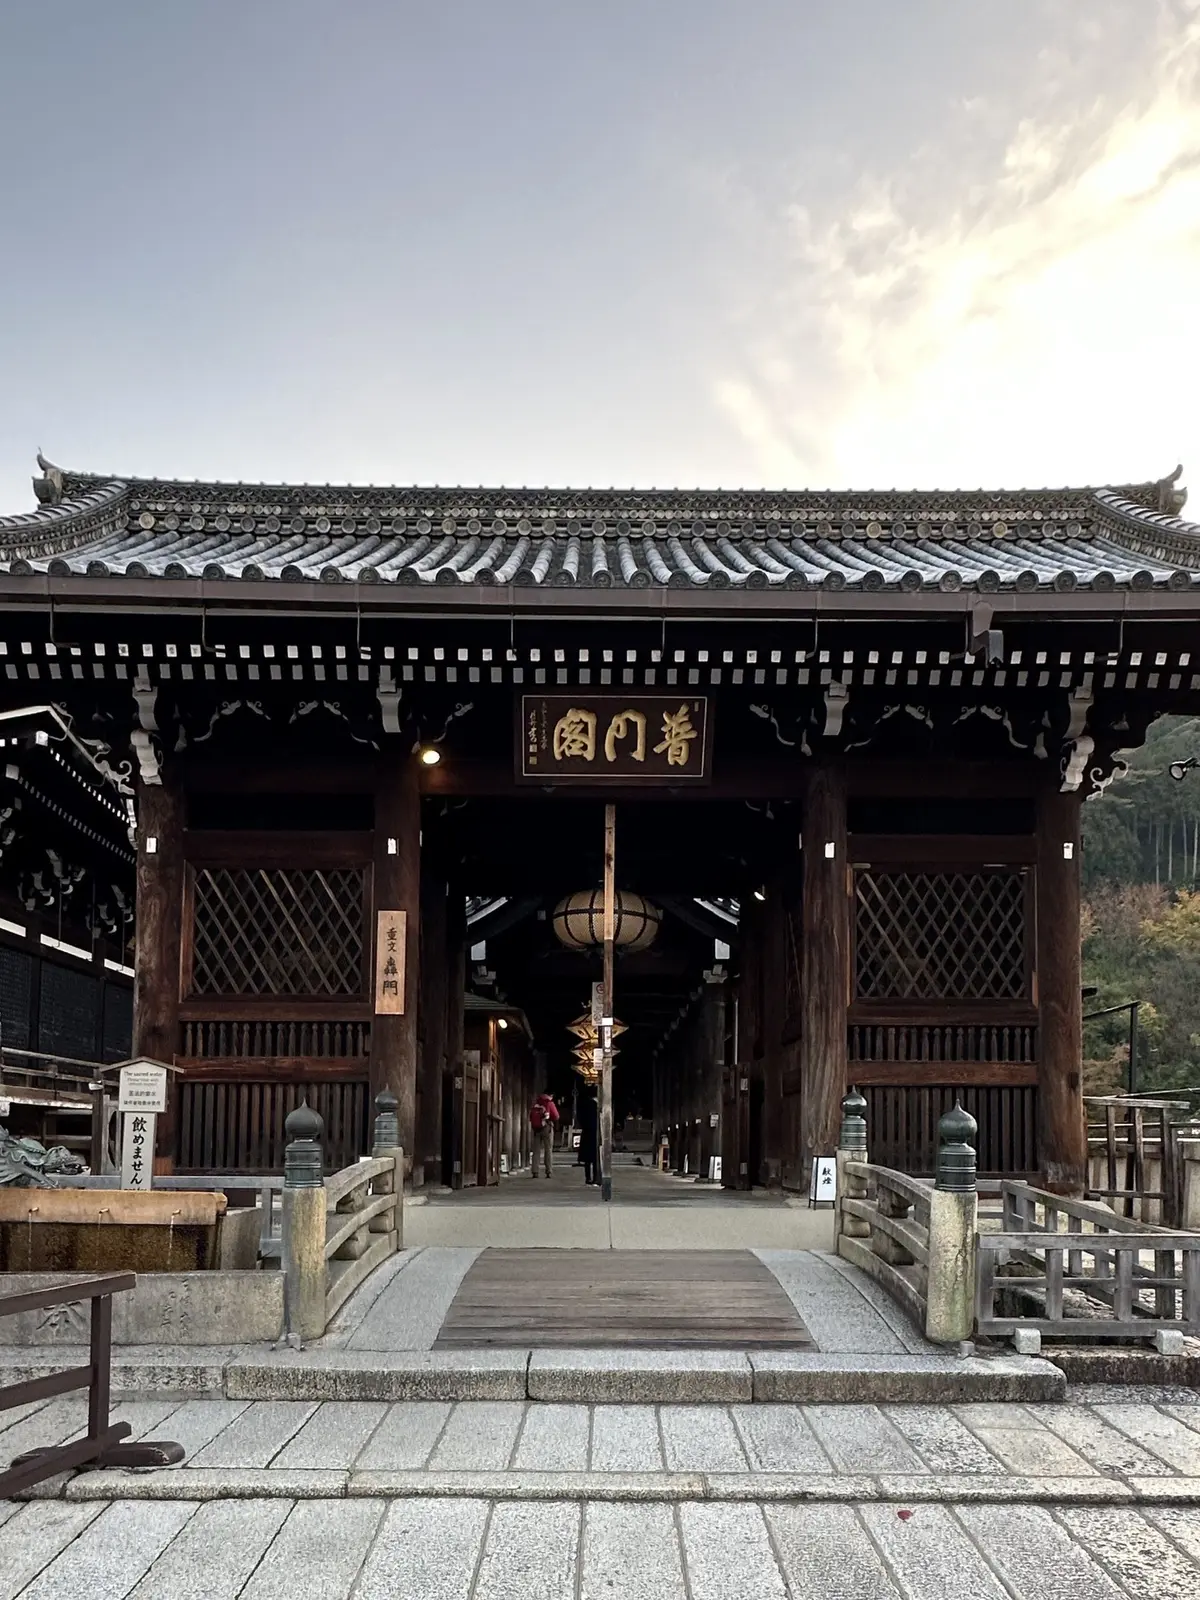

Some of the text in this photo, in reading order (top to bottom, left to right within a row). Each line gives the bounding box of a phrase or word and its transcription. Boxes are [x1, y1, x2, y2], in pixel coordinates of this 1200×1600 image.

[386, 927, 398, 952] 重文
[130, 1117, 147, 1184] 飲めません
